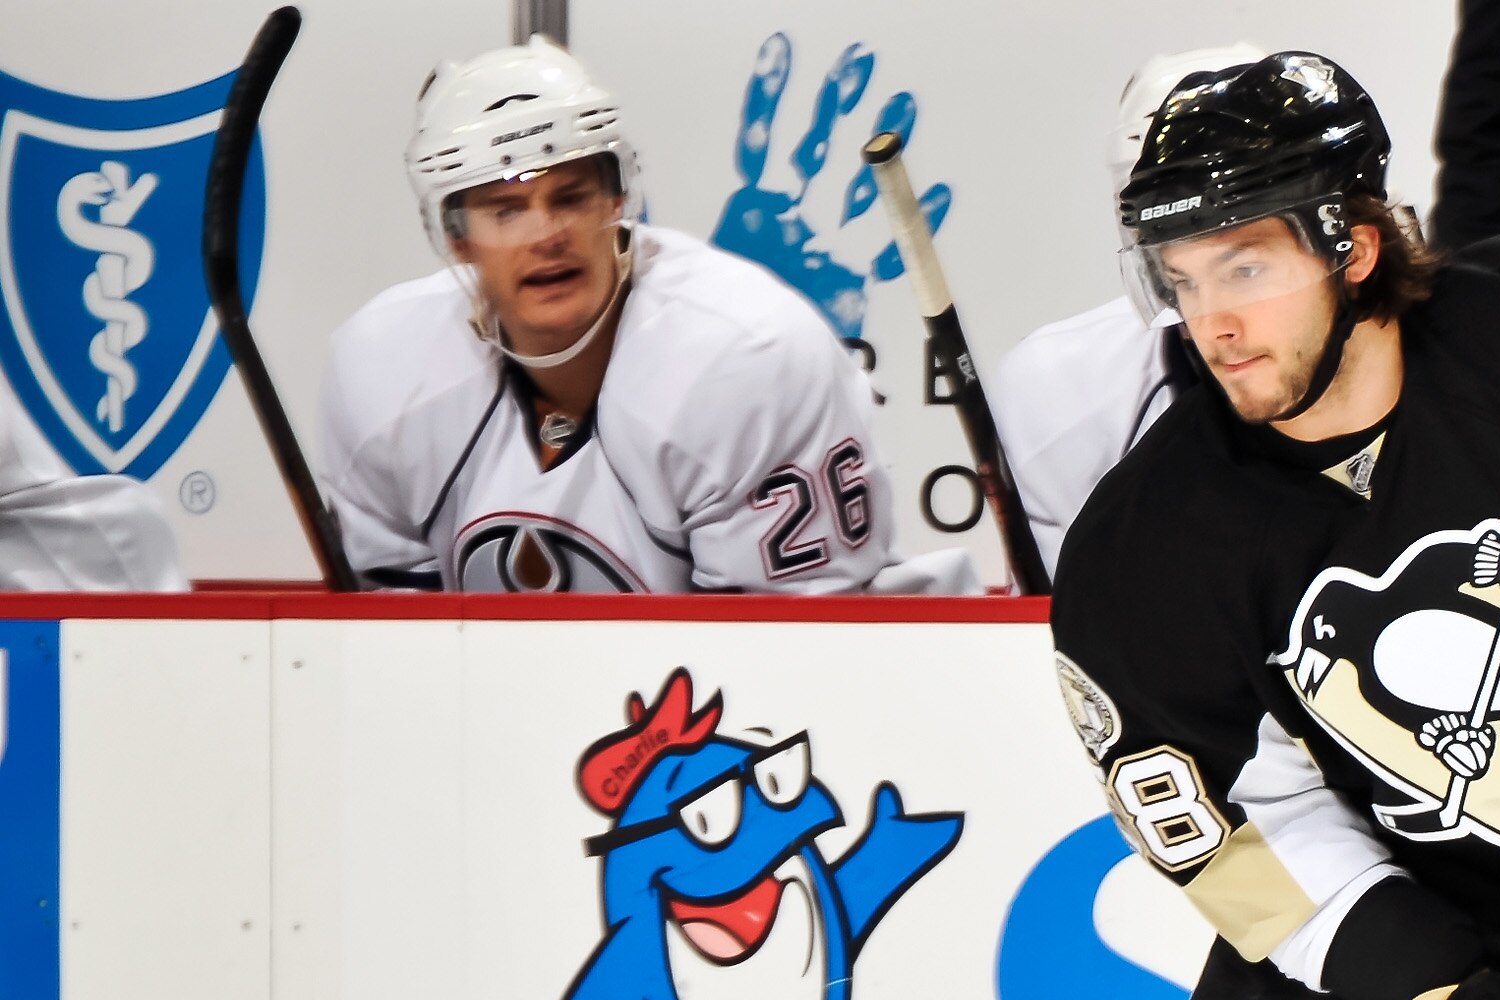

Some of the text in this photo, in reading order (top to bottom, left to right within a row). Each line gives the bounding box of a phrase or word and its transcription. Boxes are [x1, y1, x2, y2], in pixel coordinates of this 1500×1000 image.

[1140, 195, 1202, 221] BAUER
[748, 437, 874, 580] 26
[601, 727, 670, 798] Charlie
